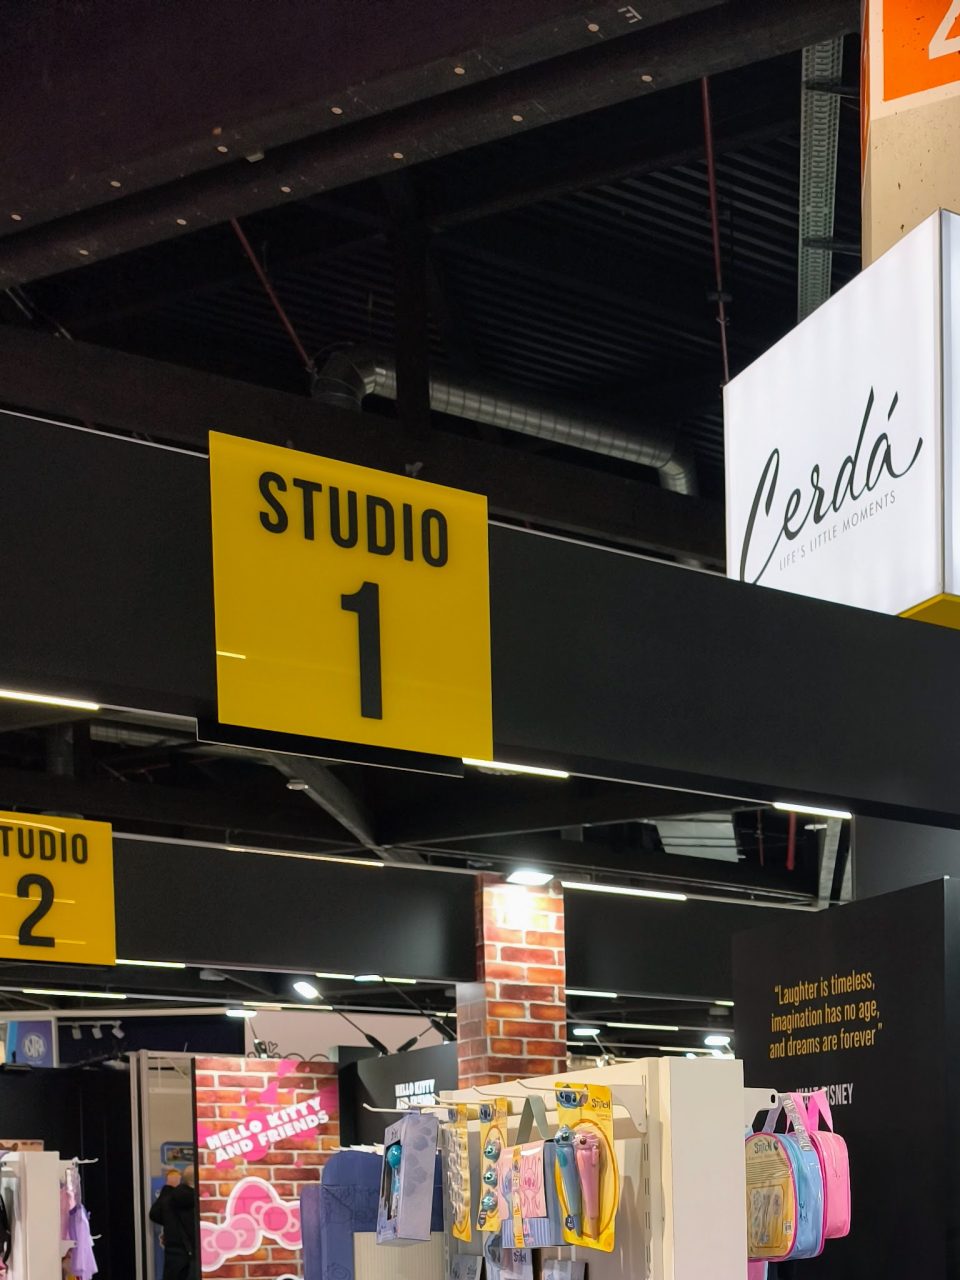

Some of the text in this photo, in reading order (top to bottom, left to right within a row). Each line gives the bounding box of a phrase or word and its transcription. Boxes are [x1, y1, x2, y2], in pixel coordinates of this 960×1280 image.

[739, 385, 923, 585] Cerdá
[258, 471, 449, 568] STUDIO
[779, 490, 896, 571] LIFE'S LITTLE MOMENTS
[341, 581, 383, 720] 1
[16, 873, 56, 948] 2
[820, 977, 828, 997] is
[830, 969, 875, 995] timeless,
[771, 1000, 880, 1034] imagination has no age,
[769, 1040, 785, 1059] and
[787, 1036, 820, 1056] dreams
[822, 1034, 837, 1051] are
[822, 1082, 853, 1106] ISNEY
[205, 1096, 321, 1150] HELLO KITTY
[214, 1110, 329, 1163] AND FRIENDS
